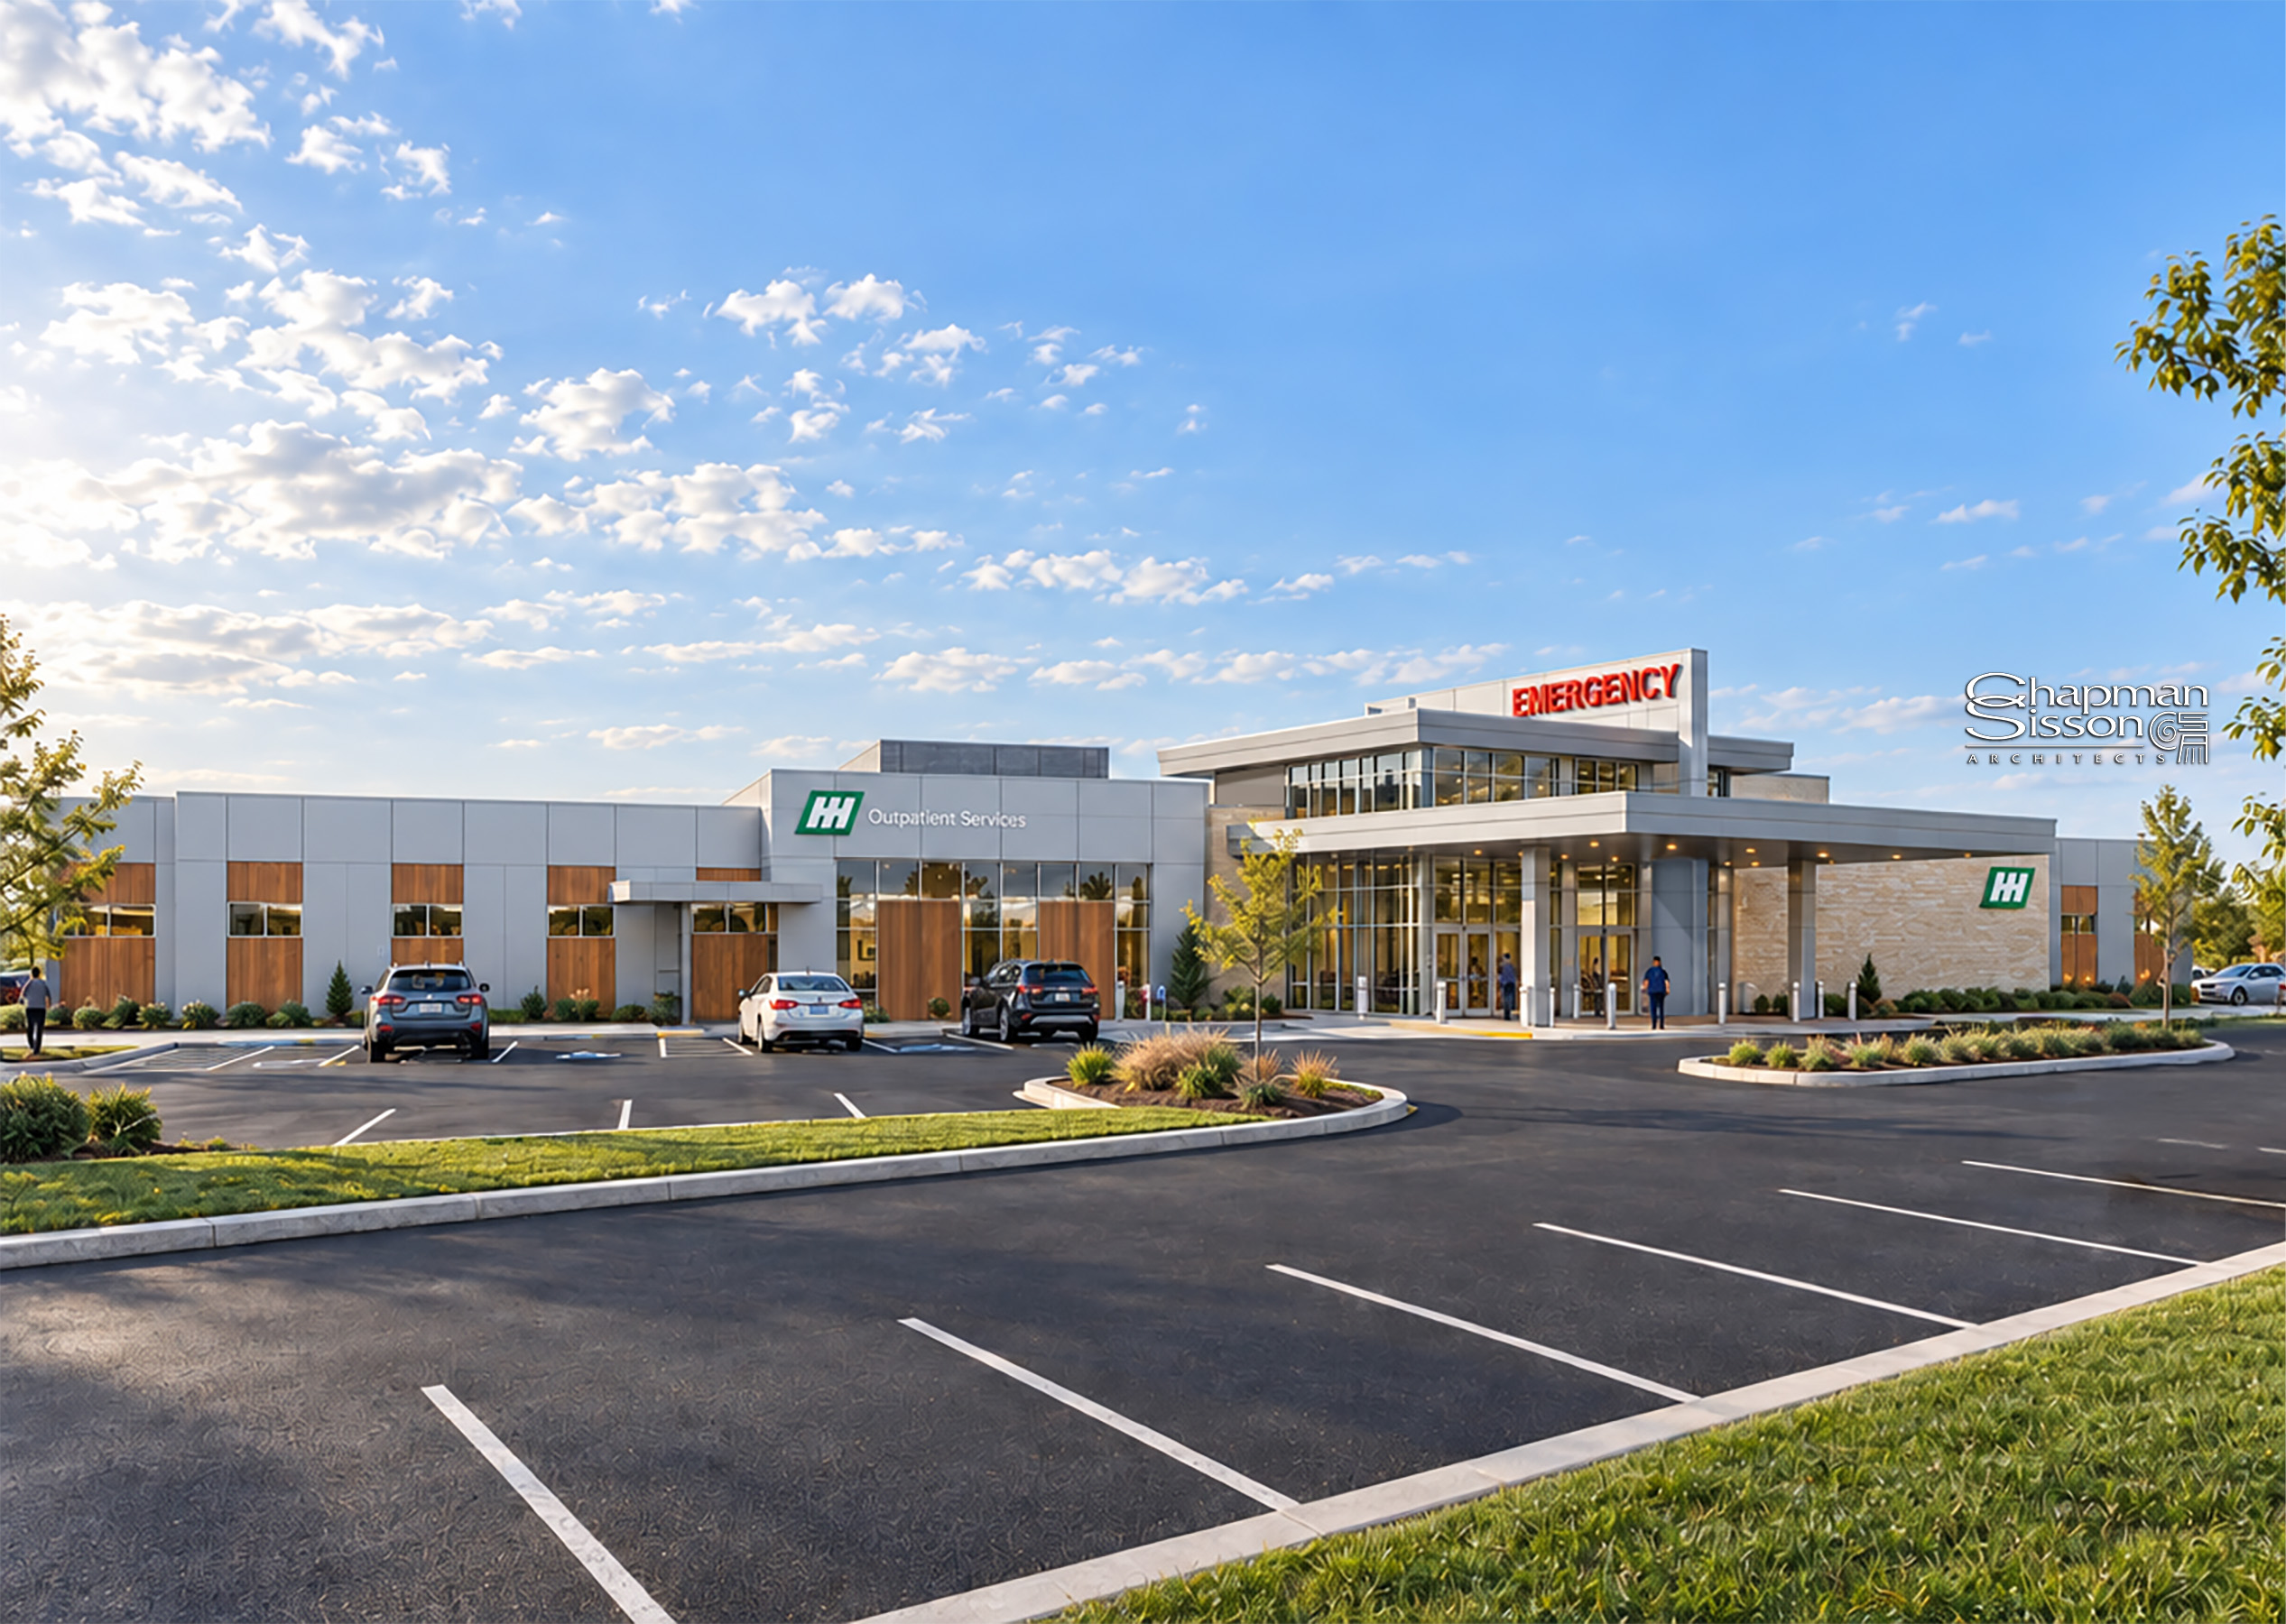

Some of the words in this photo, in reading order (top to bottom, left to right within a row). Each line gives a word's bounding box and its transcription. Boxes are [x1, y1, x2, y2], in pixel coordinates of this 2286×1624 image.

[1513, 663, 1683, 717] EMERGENCY
[868, 808, 956, 828] Outpatient
[960, 811, 1027, 828] Services
